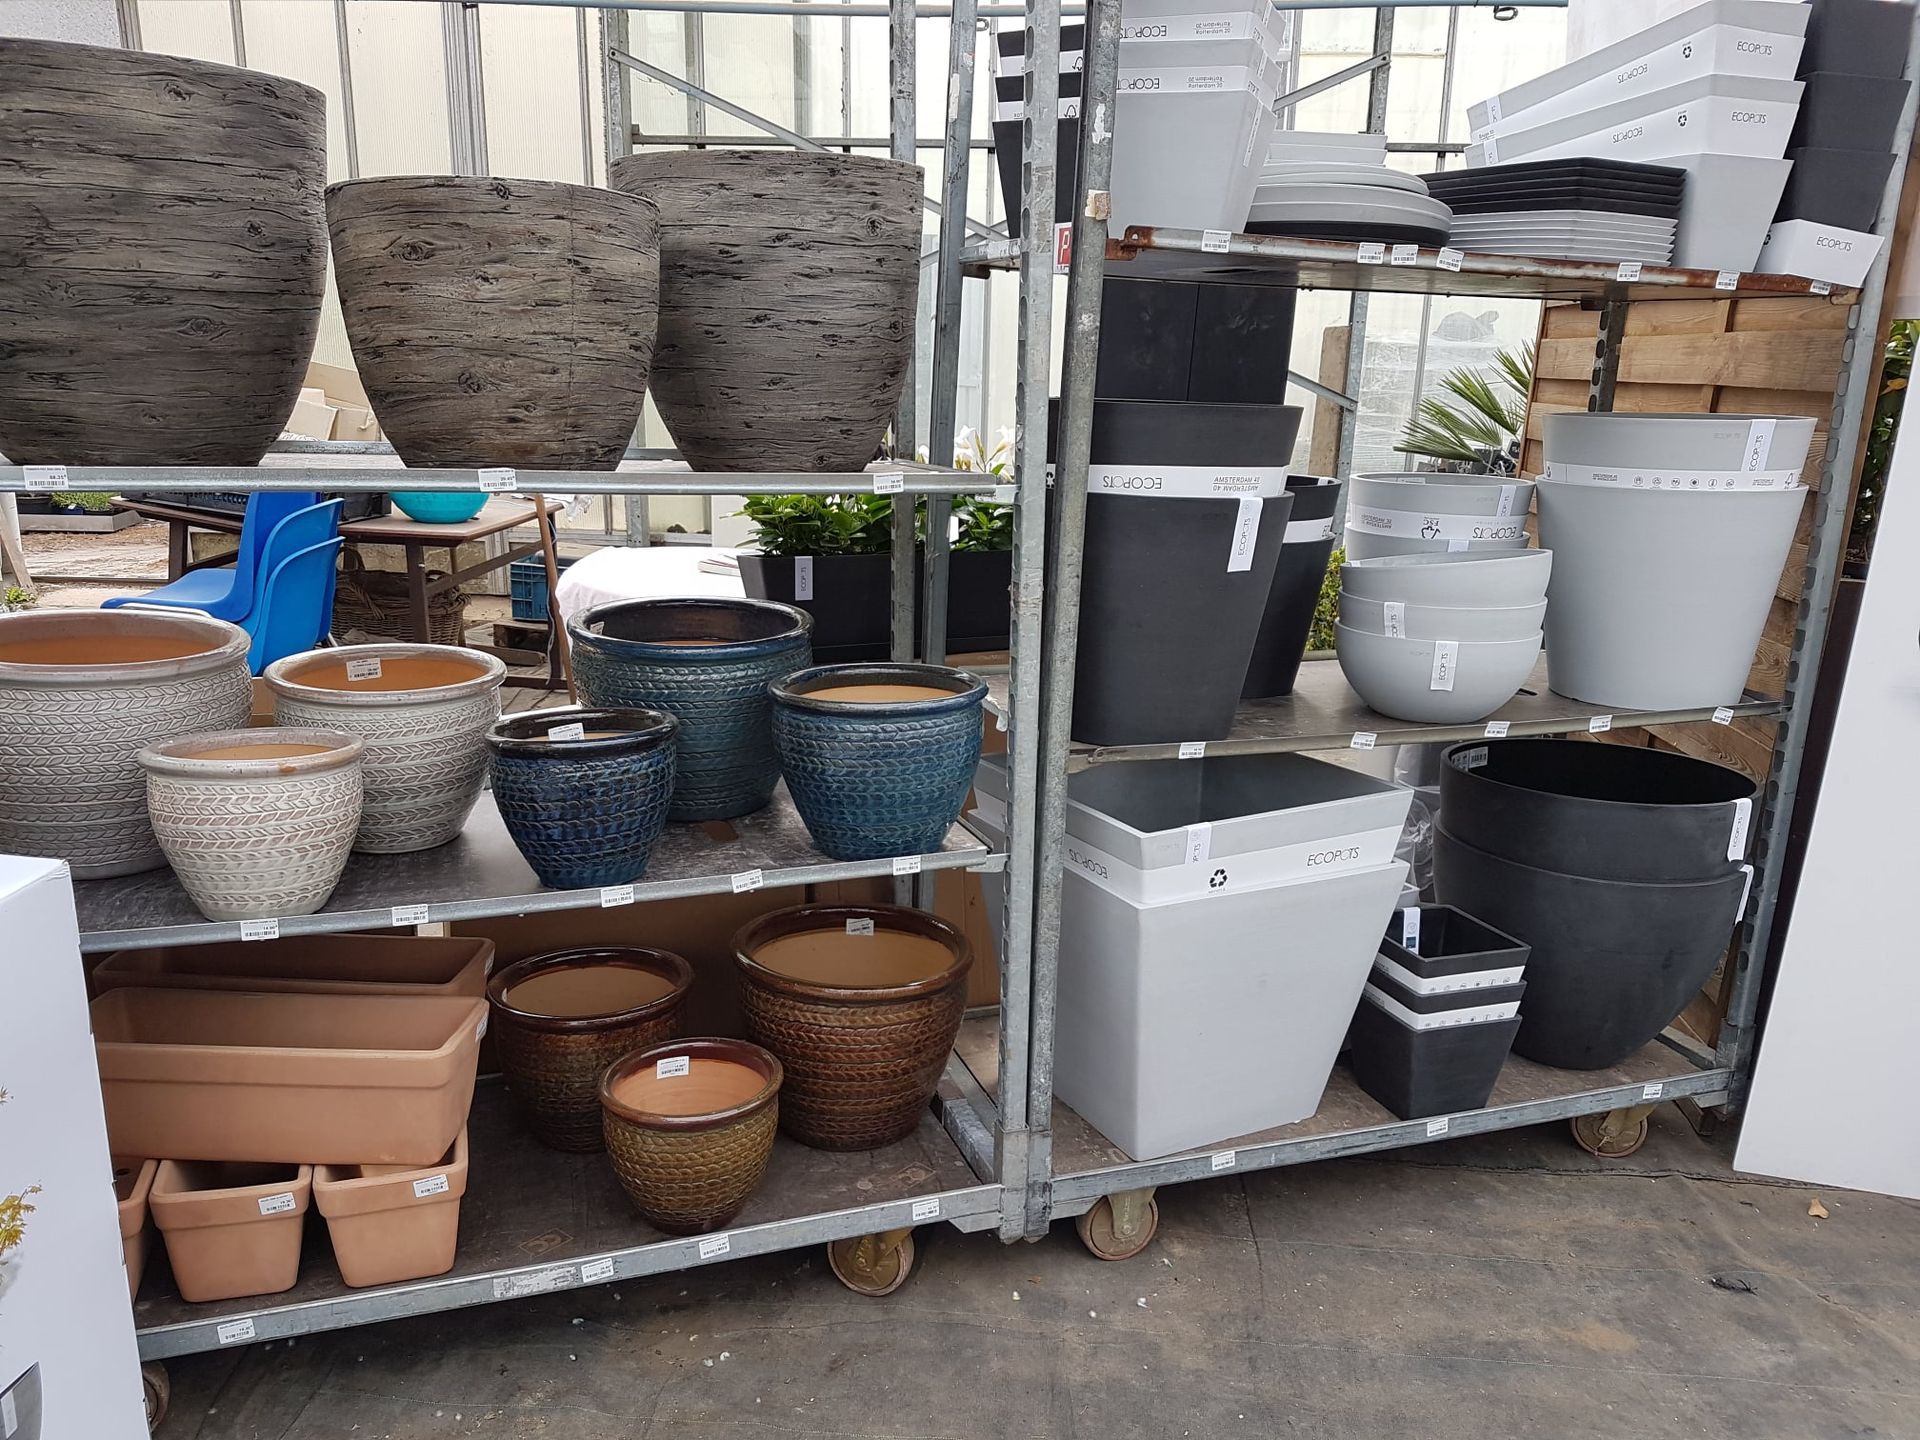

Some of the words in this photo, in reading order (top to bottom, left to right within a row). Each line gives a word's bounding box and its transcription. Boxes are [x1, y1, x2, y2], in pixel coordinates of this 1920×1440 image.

[1736, 40, 1772, 56] ECOPOTS
[1617, 63, 1648, 84] ECOPOTS
[1116, 77, 1160, 90] ECOPOT
[1731, 111, 1767, 124] ECOPOTS
[1612, 126, 1643, 144] ECOPOTS
[1816, 236, 1852, 252] ECOPOTS
[1102, 475, 1162, 490] ECOPOTS
[1237, 517, 1251, 556] ECOPOTS
[1472, 526, 1517, 539] ECOPOTS
[1068, 848, 1109, 879] ECOPOTS
[1307, 846, 1360, 867] ECOPOTS
